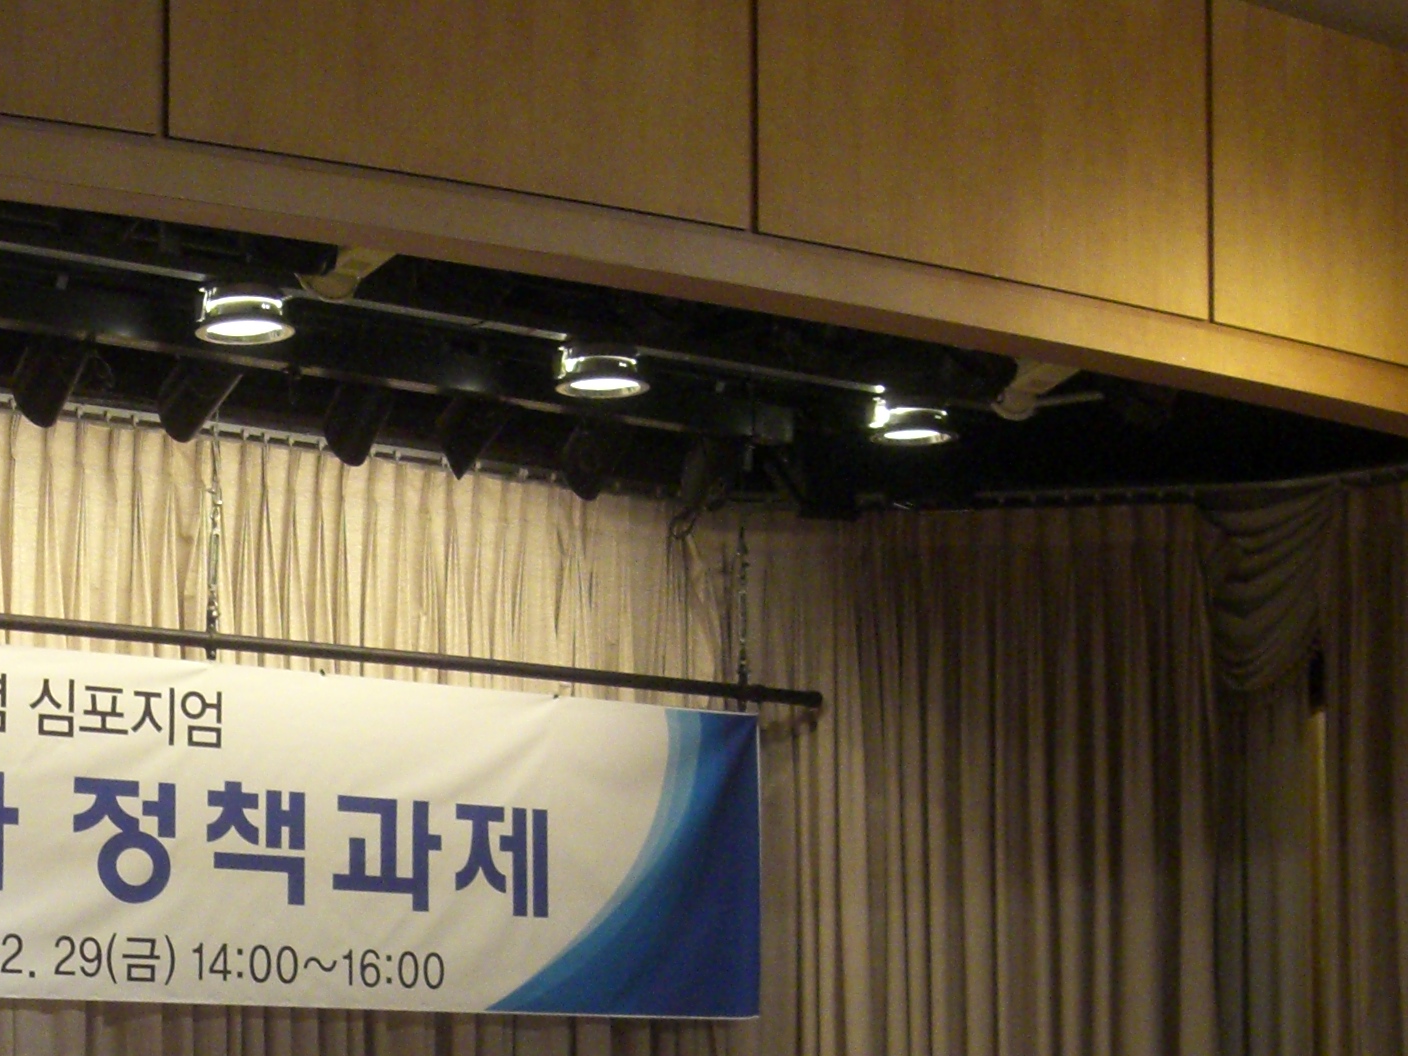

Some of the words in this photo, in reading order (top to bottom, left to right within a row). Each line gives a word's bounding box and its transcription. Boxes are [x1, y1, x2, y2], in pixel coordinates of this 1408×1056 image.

[29, 678, 224, 749] 심포지엄
[72, 776, 549, 918] 정책과제
[55, 932, 176, 986] 29(금)
[192, 942, 445, 990] 14:00~16:00
